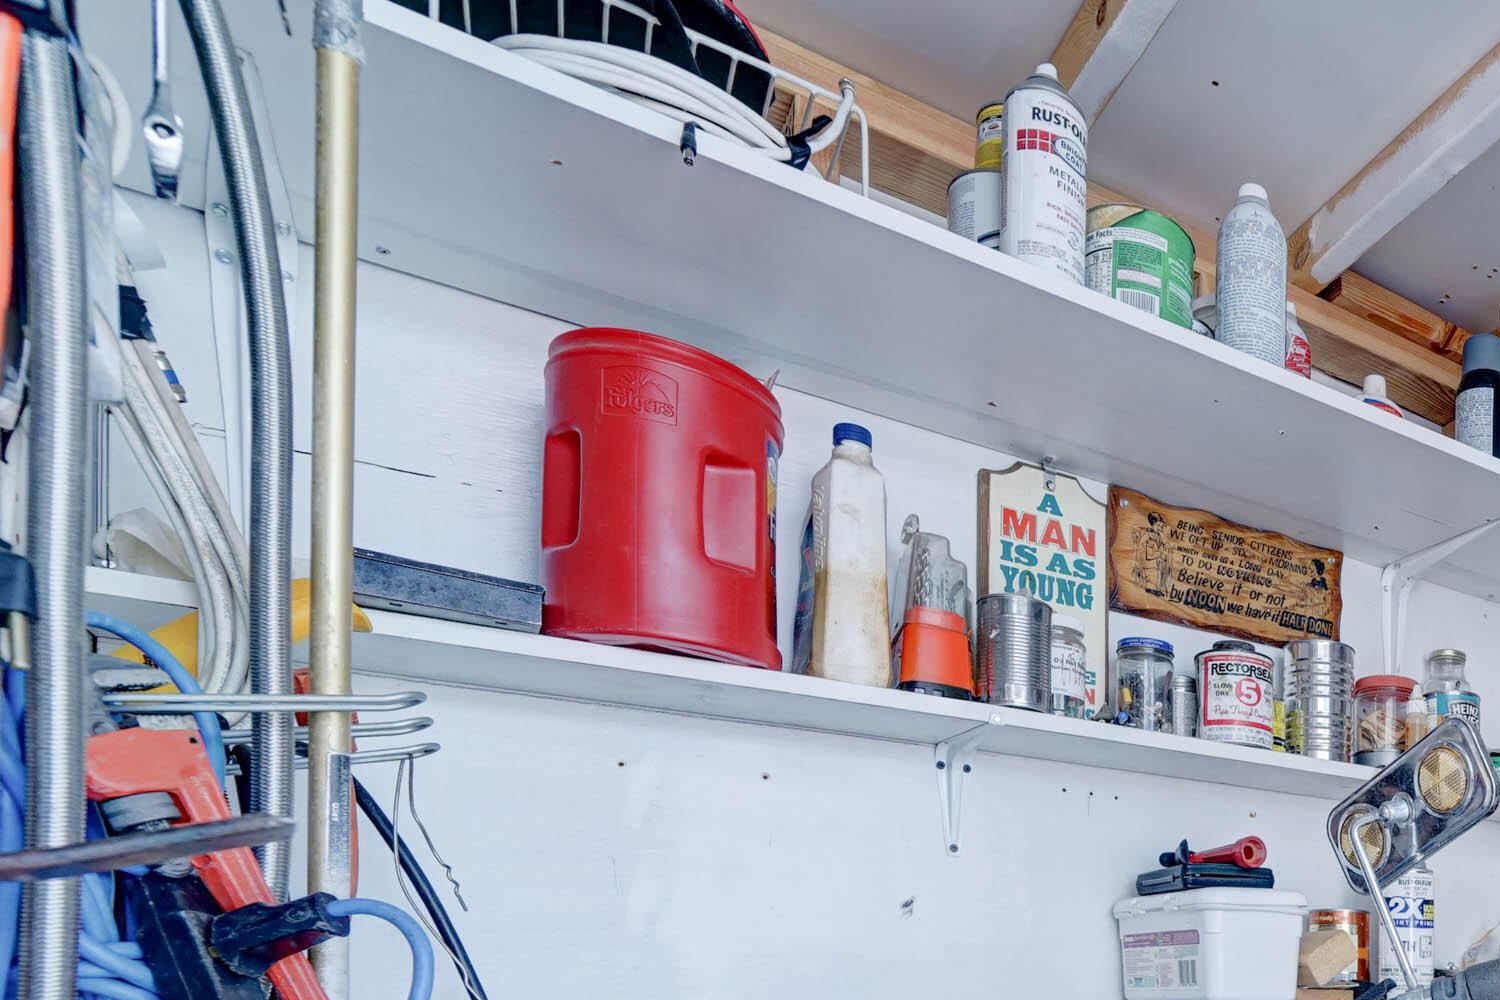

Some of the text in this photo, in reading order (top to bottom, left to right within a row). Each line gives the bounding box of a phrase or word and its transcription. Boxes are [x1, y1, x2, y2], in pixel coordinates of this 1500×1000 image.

[1032, 106, 1086, 145] RUST-OL
[1061, 140, 1086, 162] BRIGH
[1049, 165, 1086, 197] METALL
[607, 386, 675, 418] Folgers
[1037, 493, 1063, 517] A
[1001, 505, 1097, 558] MAN
[1177, 520, 1294, 560] BEING SENIOR CITIZENS
[1000, 539, 1096, 581] IS AS
[1170, 530, 1185, 541] WE
[1189, 534, 1207, 546] GET
[1211, 540, 1223, 551] UP
[1269, 558, 1307, 576] MORNING
[1181, 555, 1193, 566] TO
[1197, 560, 1212, 571] DO
[1178, 568, 1224, 592] Believe
[1232, 583, 1242, 596] it
[1249, 590, 1263, 601] or
[1239, 560, 1262, 573] LONG
[1267, 568, 1284, 579] DAY
[1000, 564, 1094, 610] YOUNG
[1170, 584, 1333, 639] by NOON we have it HALF DONE
[1239, 681, 1260, 704] 5
[1452, 702, 1479, 717] HEINZ
[1389, 896, 1425, 920] 2X
